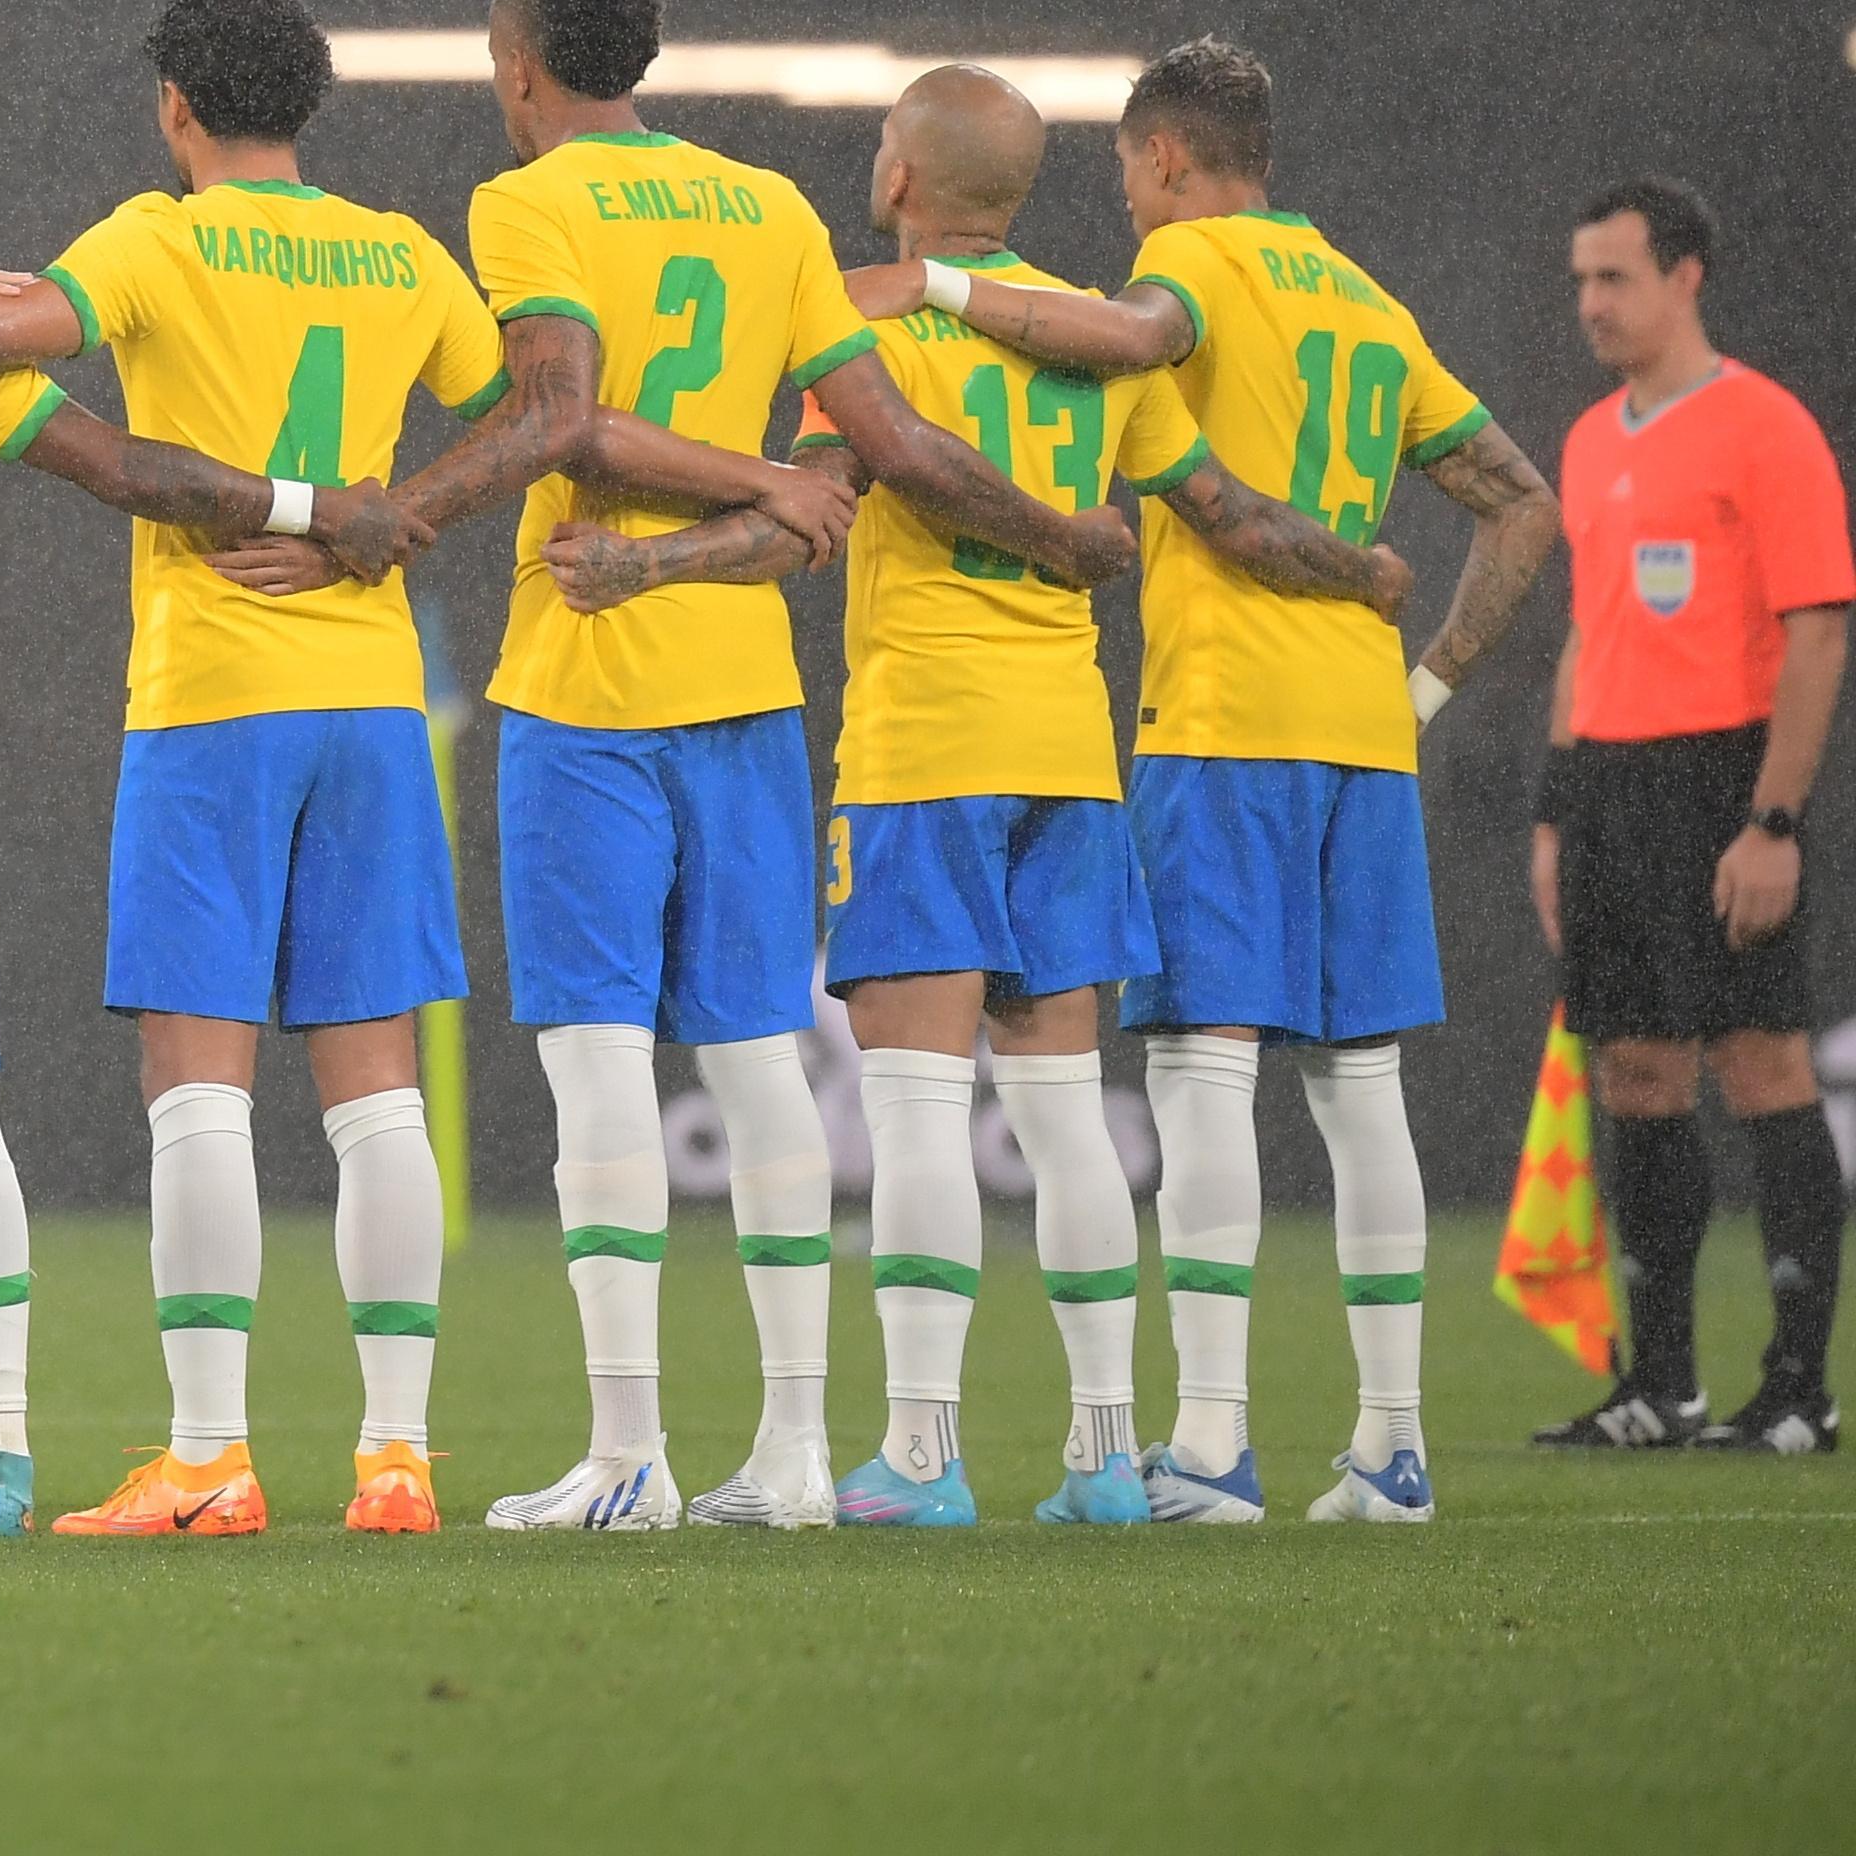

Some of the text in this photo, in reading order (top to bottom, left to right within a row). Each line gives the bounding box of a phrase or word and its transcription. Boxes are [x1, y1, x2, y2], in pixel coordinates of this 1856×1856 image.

[192, 222, 417, 290] MARQUINHOS
[586, 175, 763, 225] E.MILITÃO
[265, 324, 346, 488] 4
[634, 254, 726, 445] 2
[952, 364, 1104, 585] 13
[1289, 329, 1409, 548] 19
